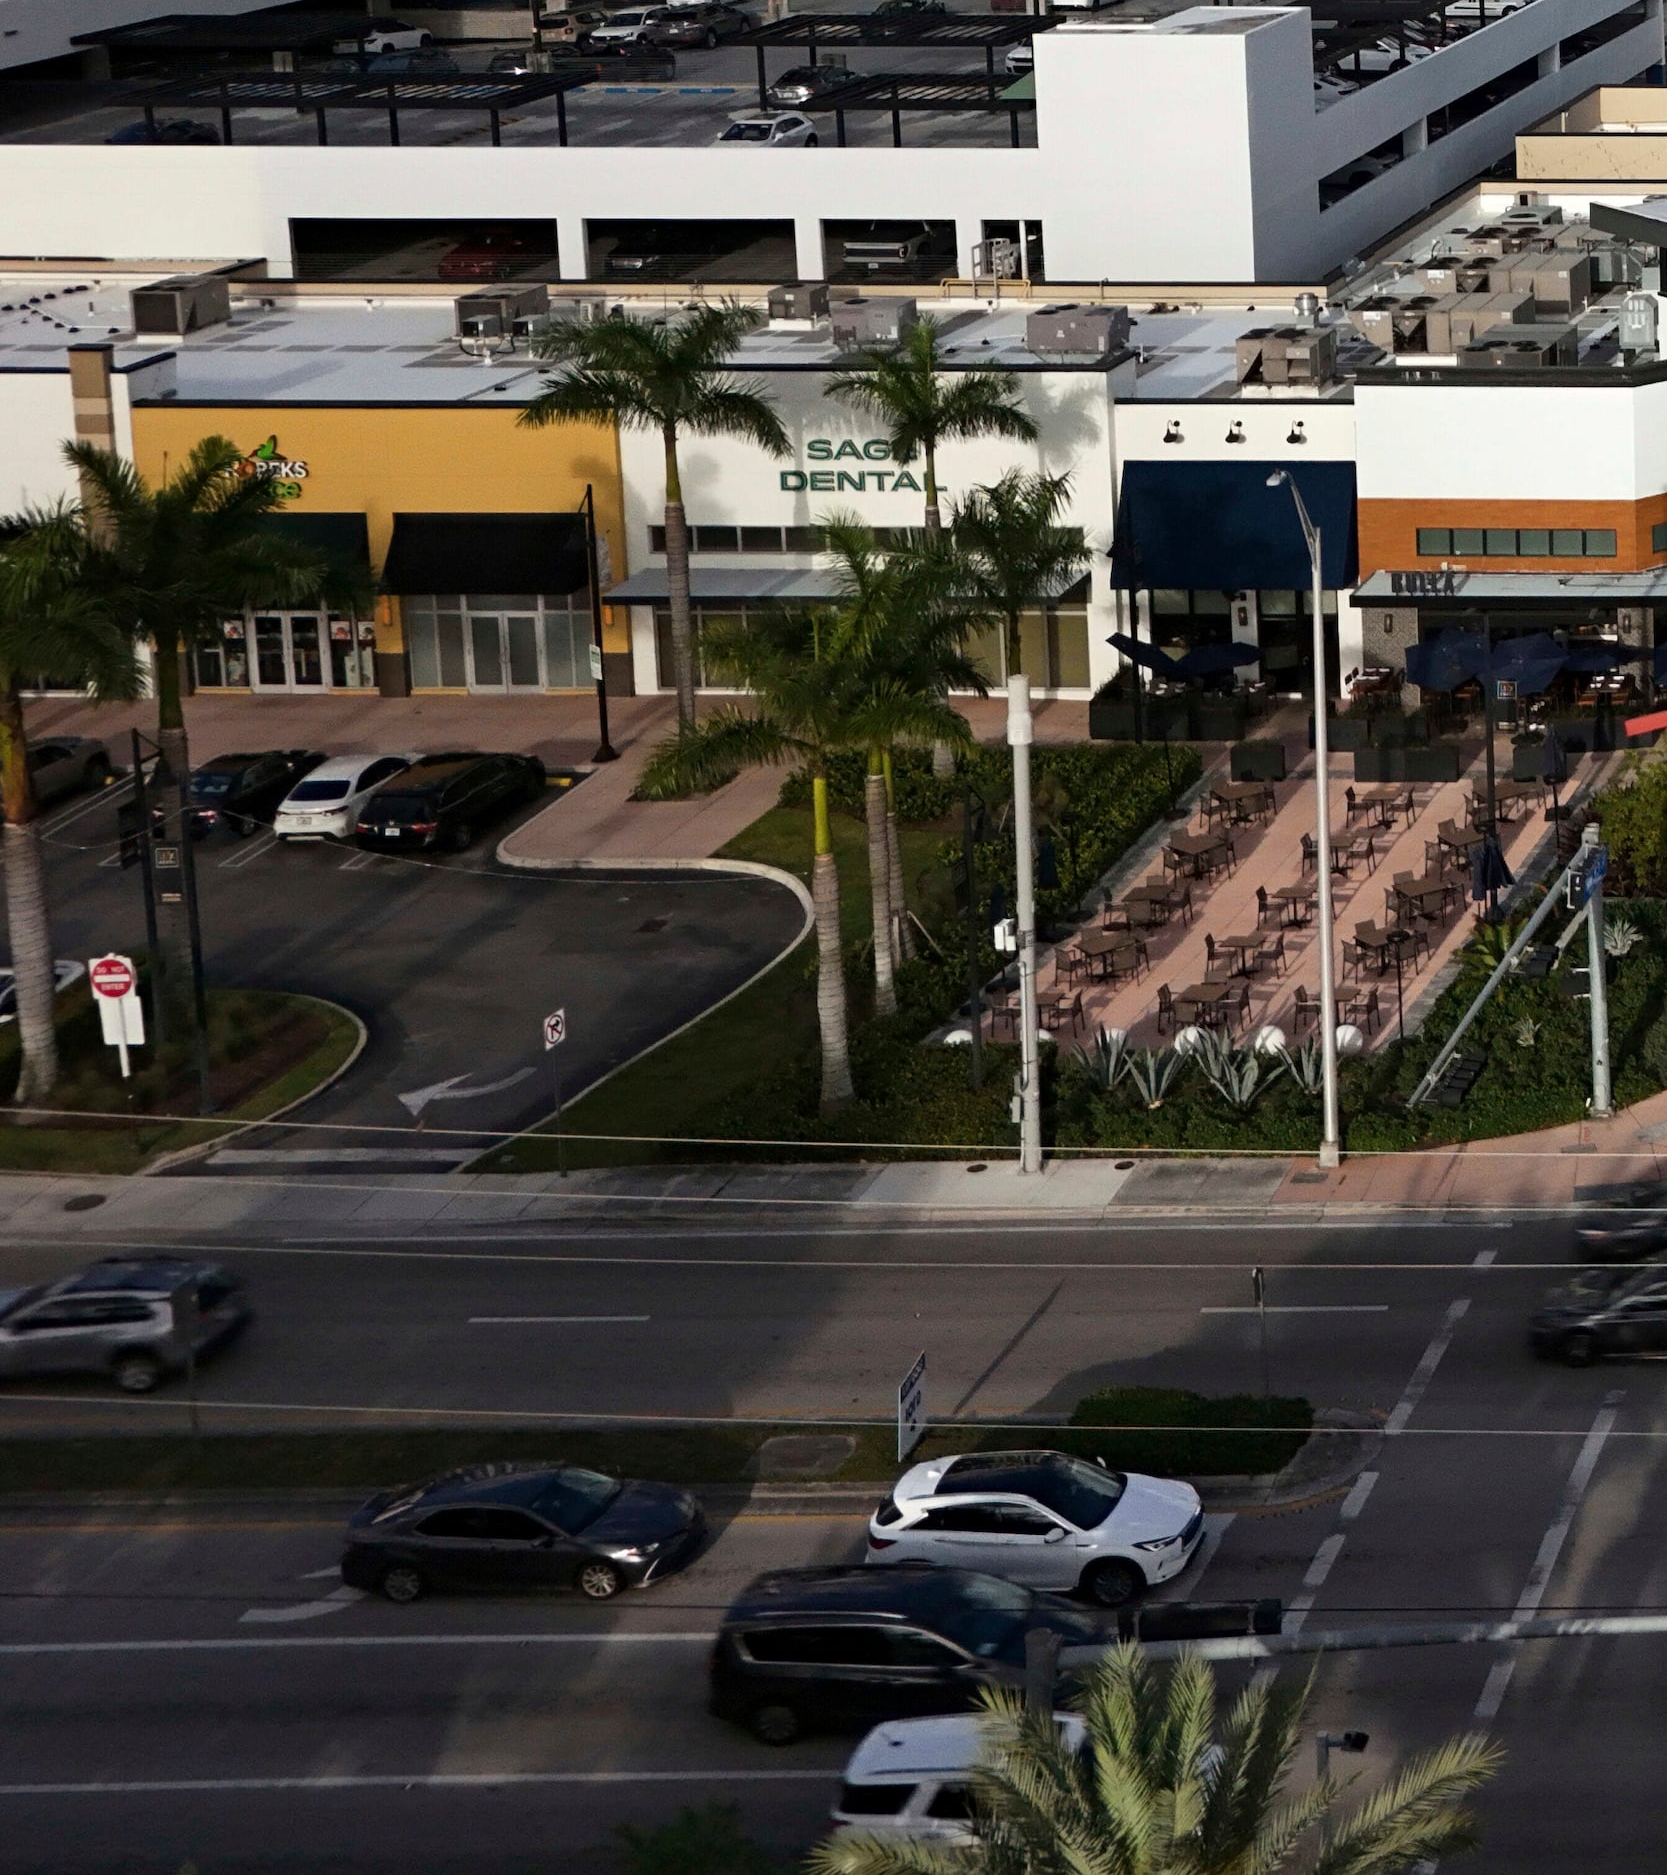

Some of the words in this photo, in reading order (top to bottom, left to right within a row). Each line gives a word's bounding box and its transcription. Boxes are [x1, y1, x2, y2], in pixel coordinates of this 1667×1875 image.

[807, 439, 914, 460] SAG
[780, 471, 948, 492] DENTAL
[96, 966, 107, 974] DO
[111, 965, 125, 974] NOT
